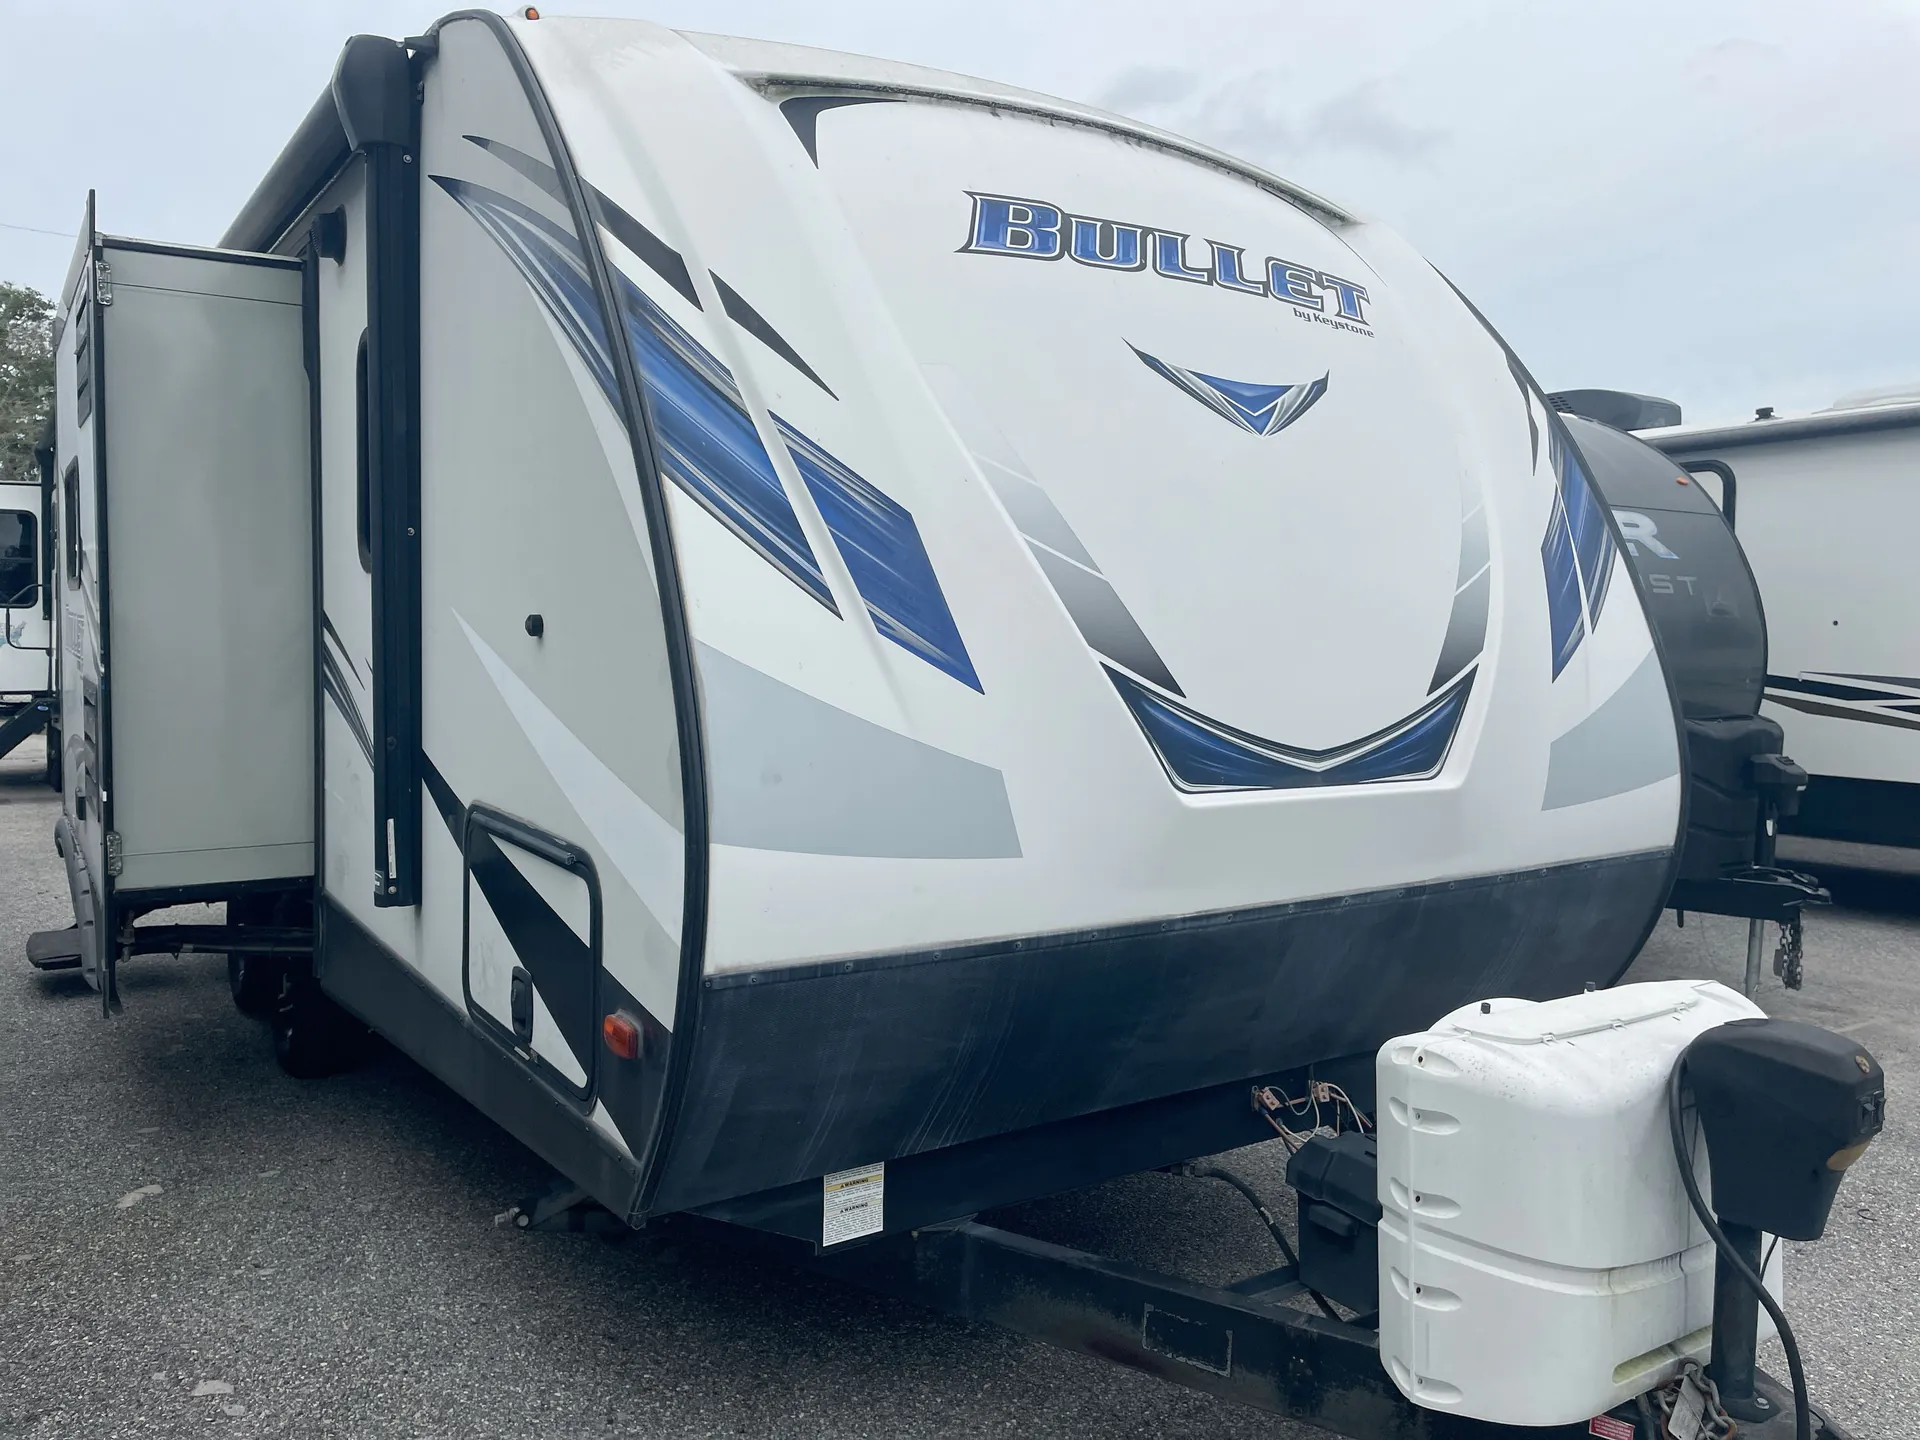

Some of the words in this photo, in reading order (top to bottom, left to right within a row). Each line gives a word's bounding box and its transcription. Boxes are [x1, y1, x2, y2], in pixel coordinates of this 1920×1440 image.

[953, 190, 1371, 326] BULLET
[1293, 307, 1311, 322] by
[1313, 312, 1375, 338] Keystone
[1639, 573, 1697, 596] ST
[844, 1177, 869, 1187] WARNING
[844, 1201, 869, 1212] WARNING
